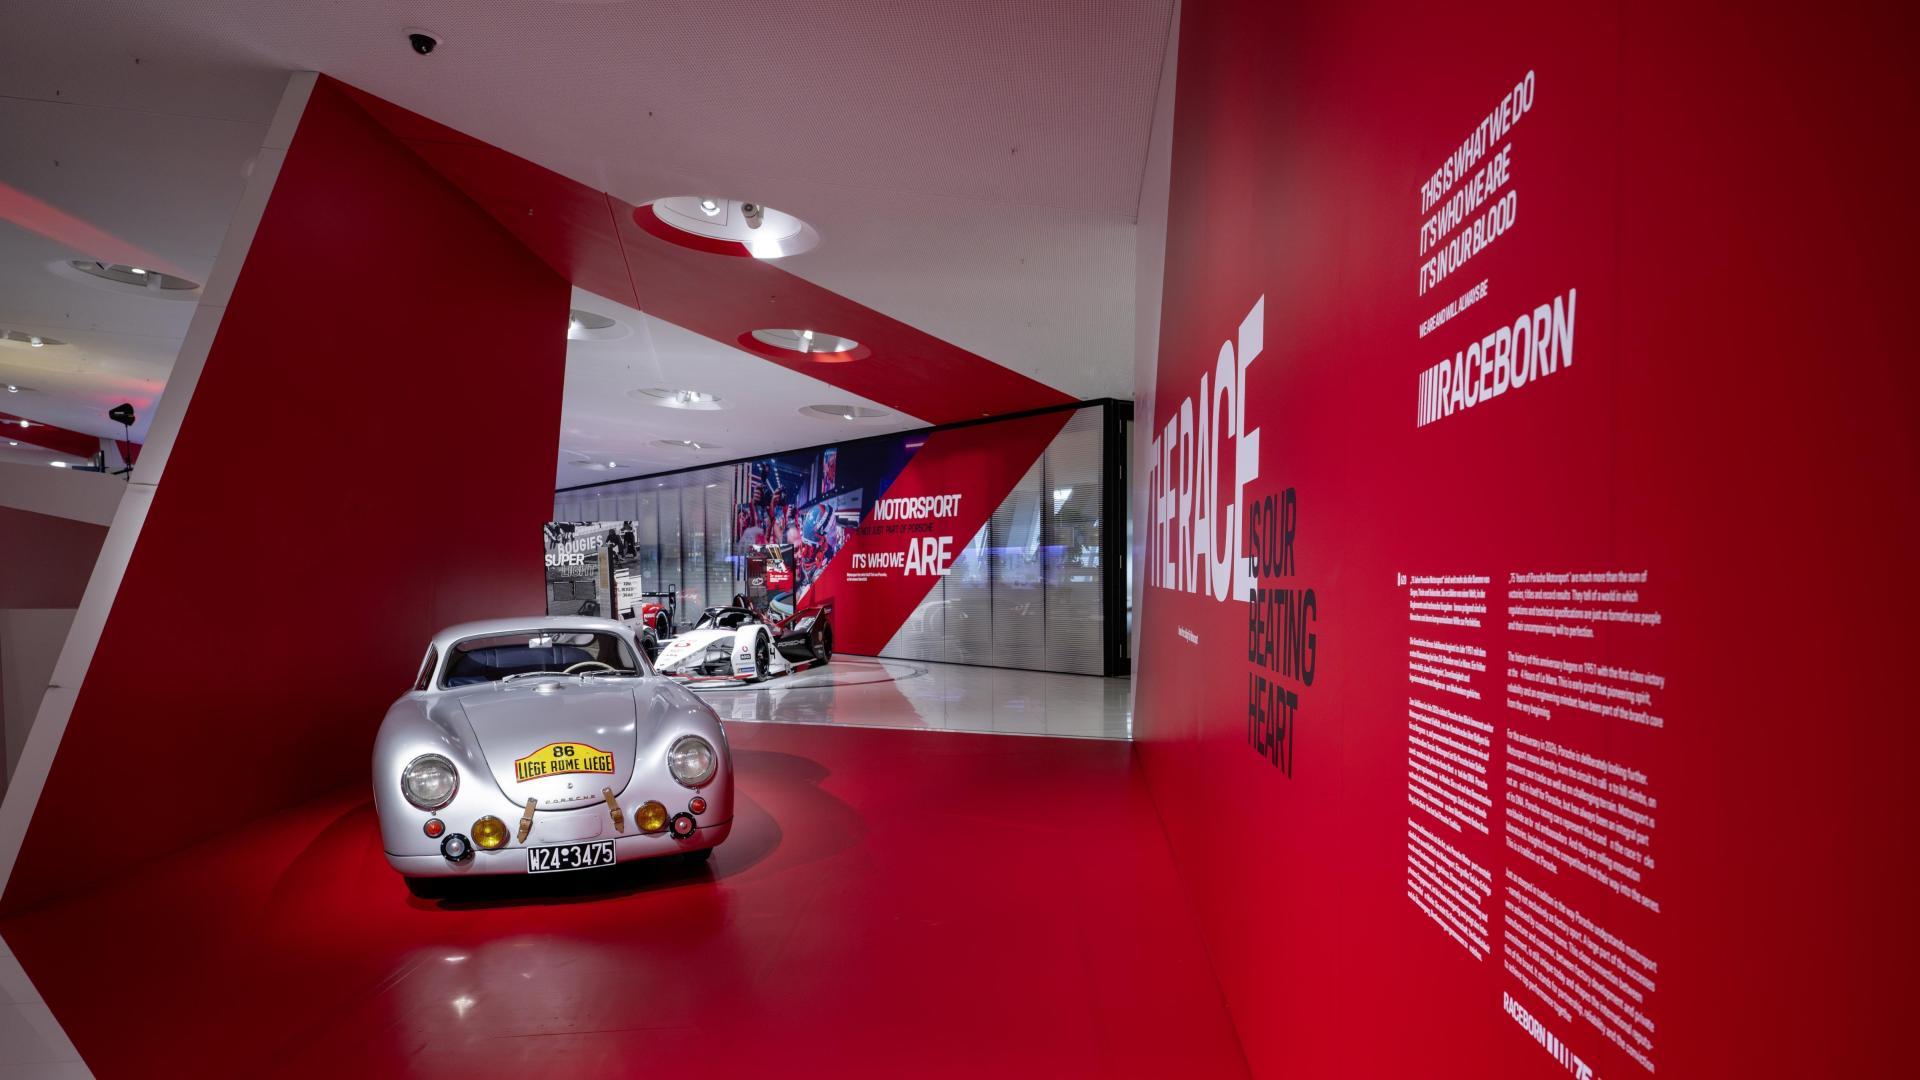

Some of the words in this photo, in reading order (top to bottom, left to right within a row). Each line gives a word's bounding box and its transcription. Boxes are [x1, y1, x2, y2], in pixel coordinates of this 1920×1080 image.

[1421, 168, 1443, 215] THIS
[1443, 156, 1453, 194] IS
[1454, 116, 1490, 182] WHAT
[1489, 92, 1512, 147] WE
[1512, 69, 1535, 125] DO
[1420, 214, 1437, 257] IT'S
[1437, 190, 1464, 240] WHO
[1465, 167, 1485, 216] WE
[1484, 142, 1512, 200] ARE
[1419, 256, 1437, 297] IT'S
[1437, 246, 1448, 283] IN
[1449, 226, 1472, 273] OUR
[1473, 189, 1517, 255] BLOOD
[1437, 287, 1577, 417] RACEBORN
[1148, 412, 1178, 591] THE
[1179, 294, 1265, 603] RACE
[874, 494, 962, 521] MOTORSPORT
[1249, 500, 1260, 578] IS
[1260, 487, 1297, 578] OUR
[545, 553, 585, 567] SUPER
[558, 535, 603, 555] BOUGIES
[561, 564, 595, 578] LIGHT
[852, 553, 867, 569] IT'S
[868, 553, 890, 569] WHO
[889, 552, 905, 569] WE
[904, 516, 954, 577] ARE
[769, 647, 776, 660] 4
[1248, 587, 1317, 687] BEATING
[553, 745, 575, 758] 86
[1248, 671, 1298, 780] HEART
[550, 759, 581, 773] ROME
[545, 794, 596, 804] PORSCHE
[1503, 991, 1547, 1047] RACEBORN
